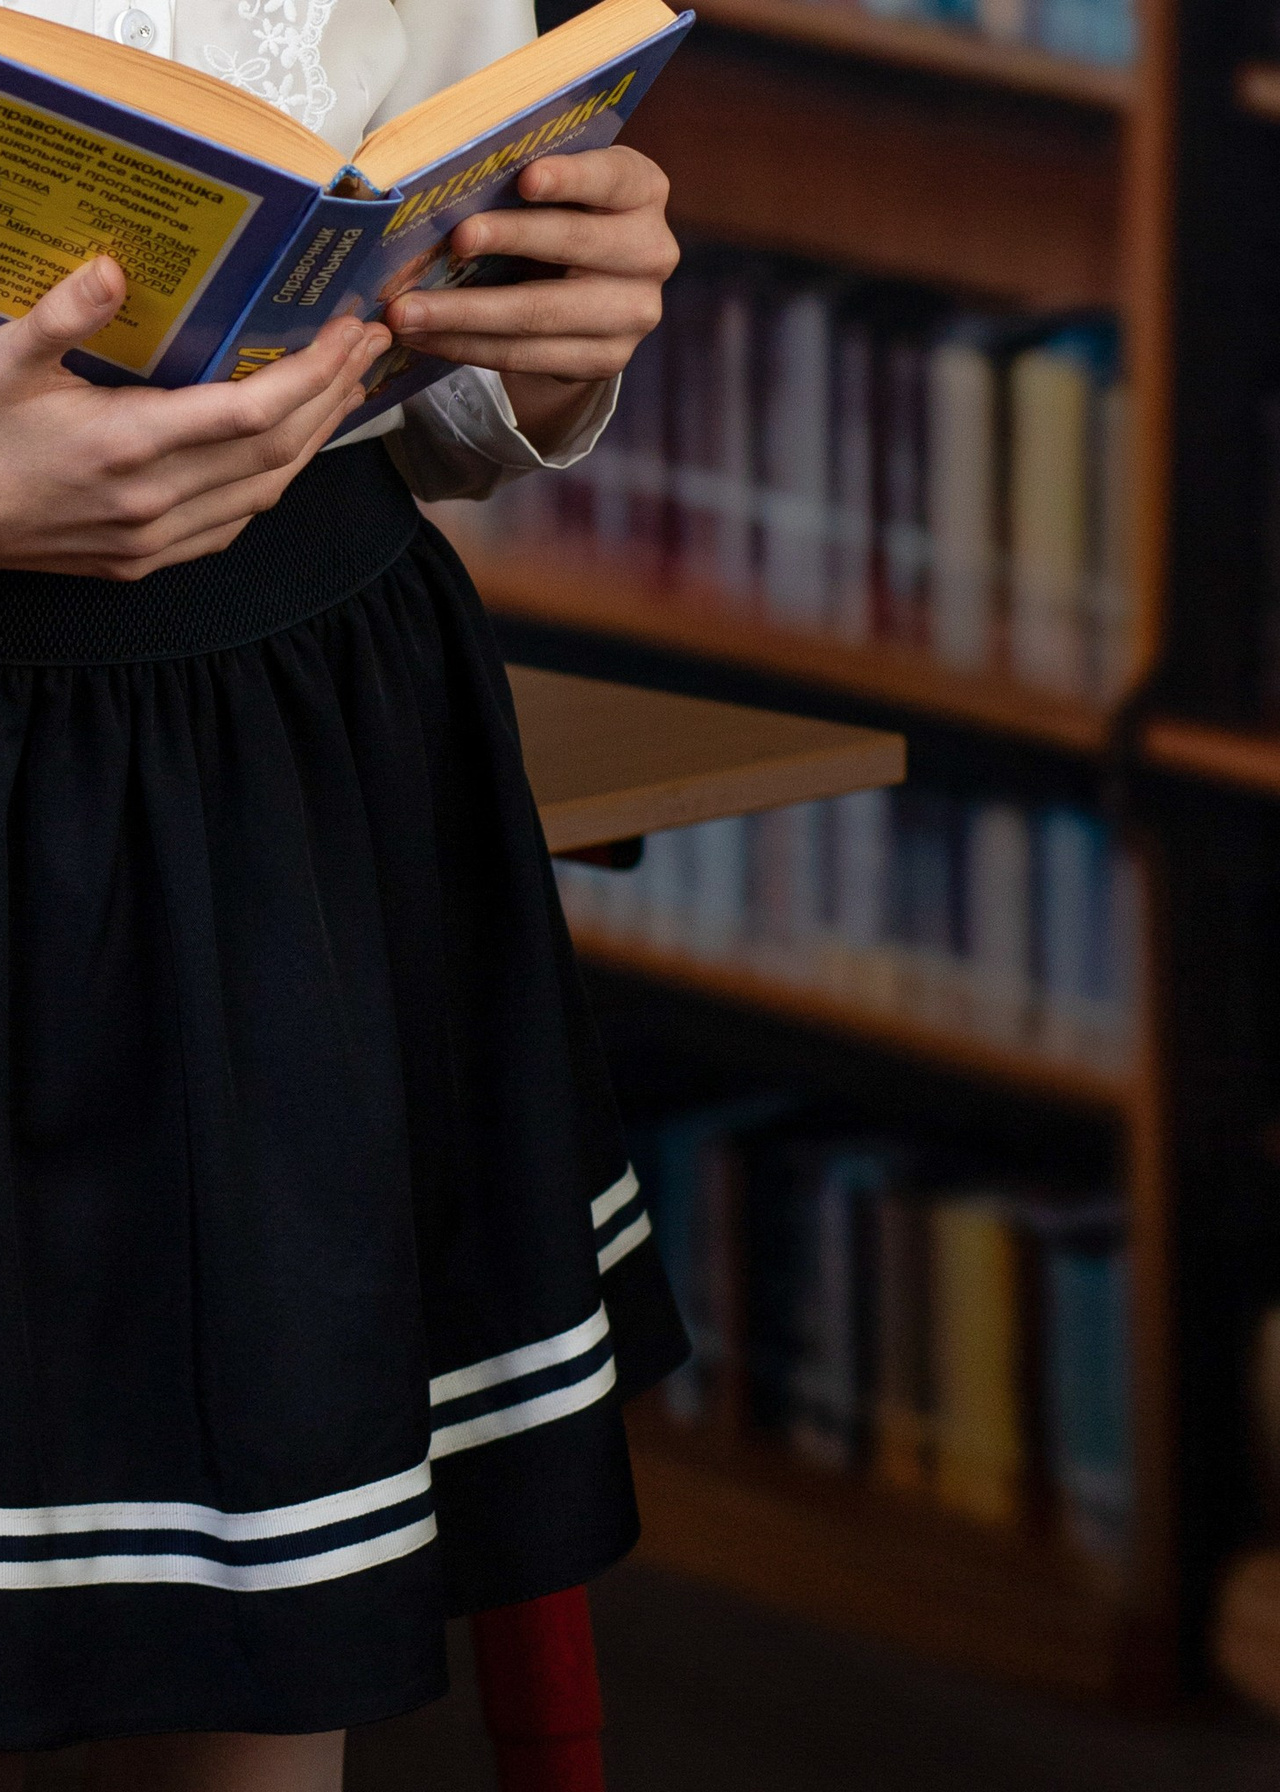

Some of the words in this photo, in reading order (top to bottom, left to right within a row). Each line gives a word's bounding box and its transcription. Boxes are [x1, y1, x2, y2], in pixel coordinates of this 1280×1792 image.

[82, 168, 180, 215] программы
[95, 159, 127, 177] все
[129, 172, 199, 207] аспекты
[74, 180, 96, 193] из
[97, 188, 195, 235] предметов:
[76, 198, 154, 237] РУССКИЙ
[153, 231, 200, 256] ЯЗЫК
[4, 217, 87, 258] МИРОВОЙ
[88, 216, 194, 266] ЛИТЕРАТУРА
[109, 238, 188, 276] ИСТОРИЯ
[86, 239, 183, 285] ГЕОГРАФИЯ
